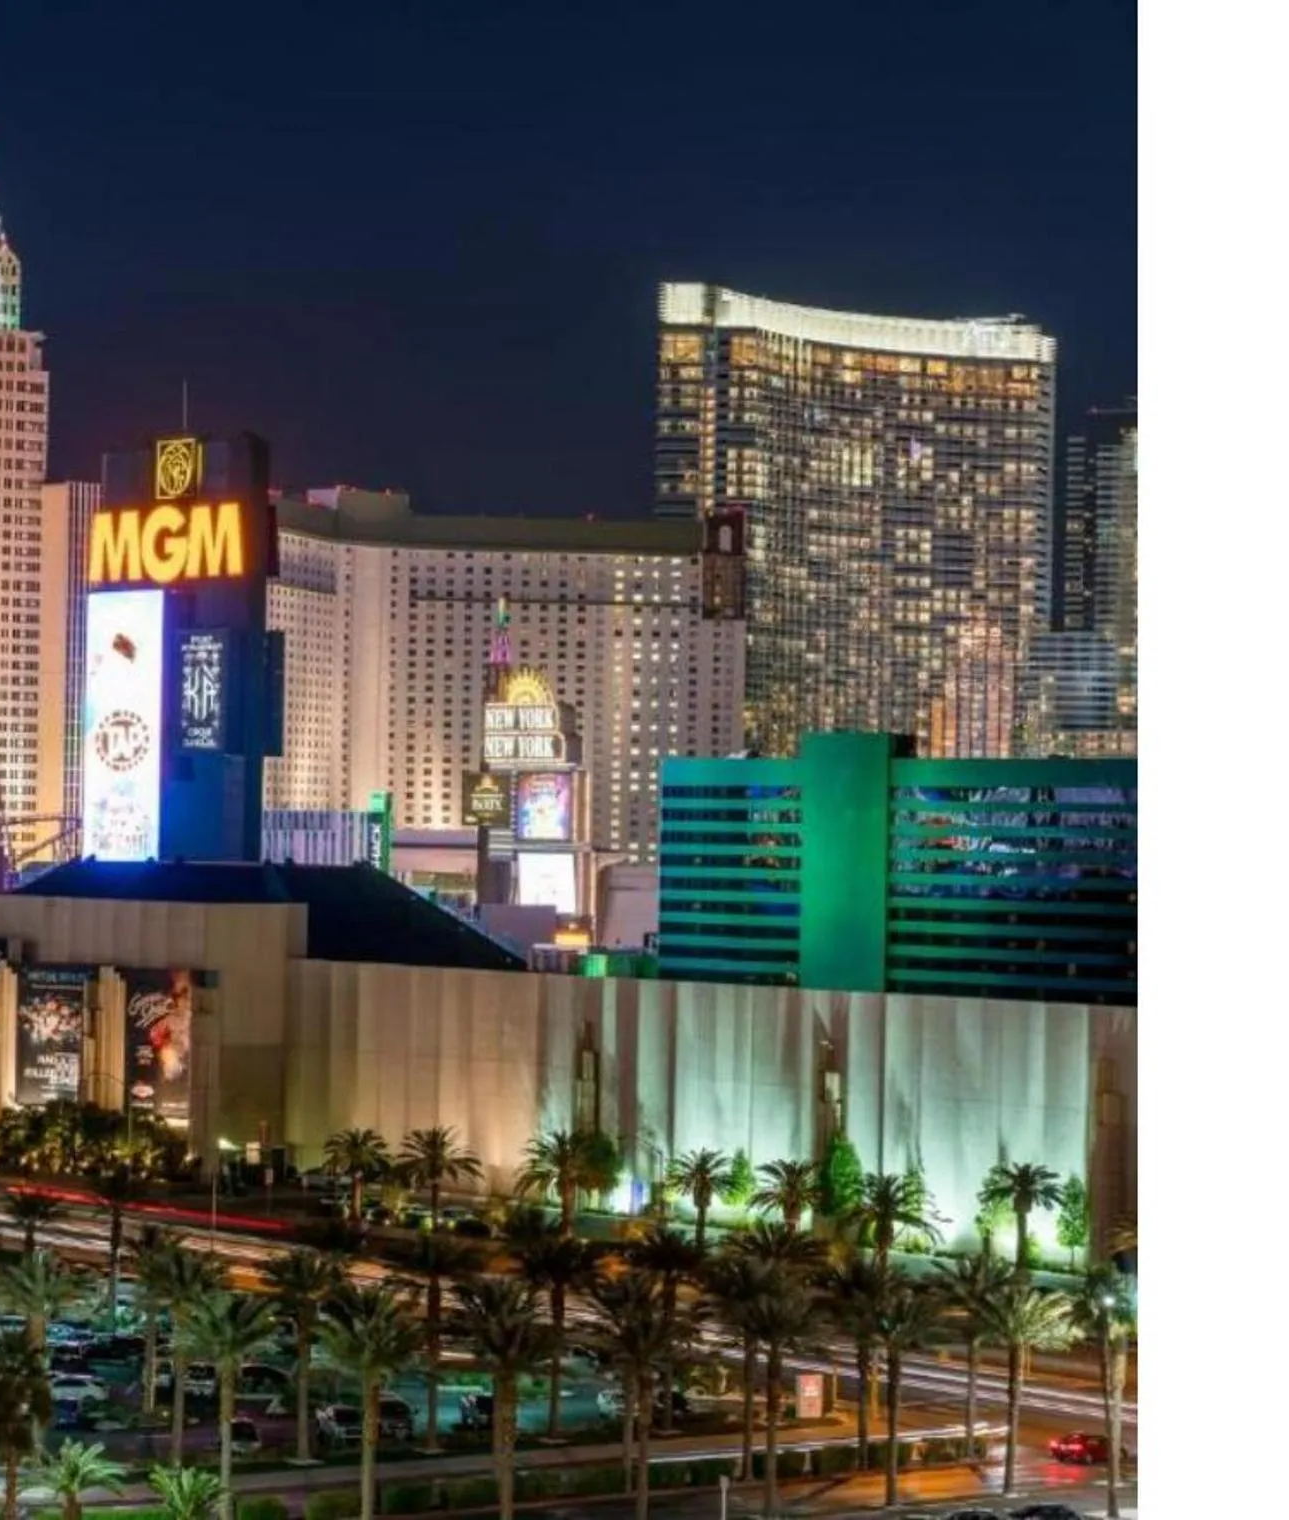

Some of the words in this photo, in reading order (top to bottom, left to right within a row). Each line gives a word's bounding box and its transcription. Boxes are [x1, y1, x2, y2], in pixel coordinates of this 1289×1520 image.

[89, 502, 244, 583] MGM
[486, 707, 516, 730] NEW
[519, 707, 554, 730] YORK
[484, 735, 516, 758] NEW
[518, 735, 554, 758] YORK
